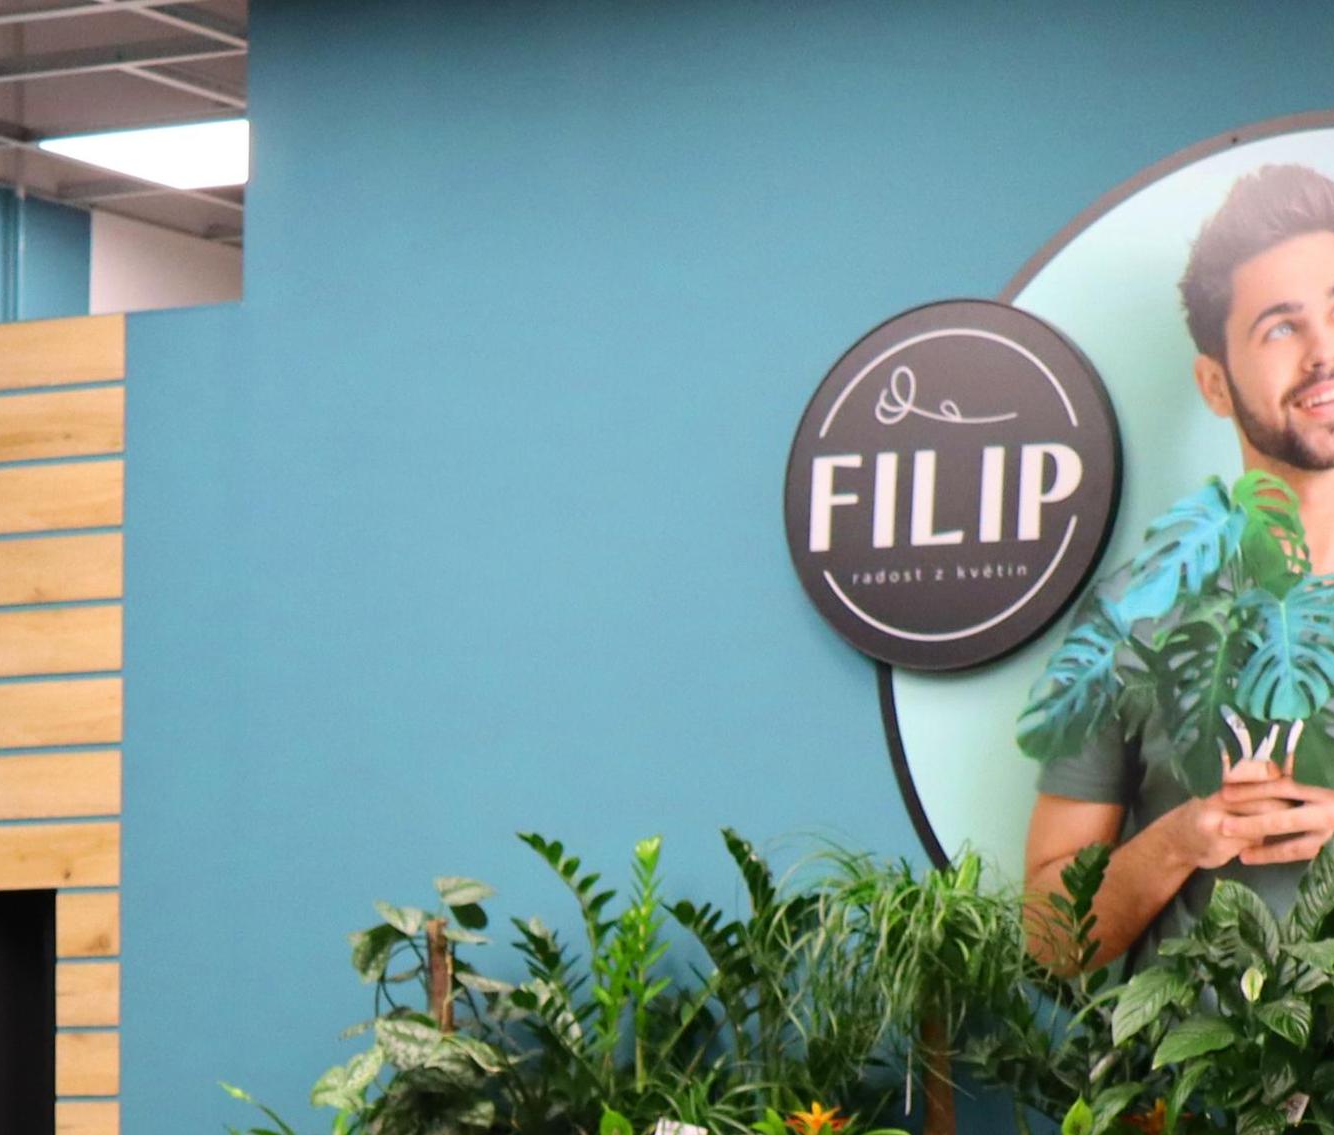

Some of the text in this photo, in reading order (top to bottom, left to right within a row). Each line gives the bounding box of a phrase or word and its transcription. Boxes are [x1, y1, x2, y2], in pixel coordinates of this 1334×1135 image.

[808, 443, 1083, 552] FILIP
[852, 561, 1029, 585] radost z květin
